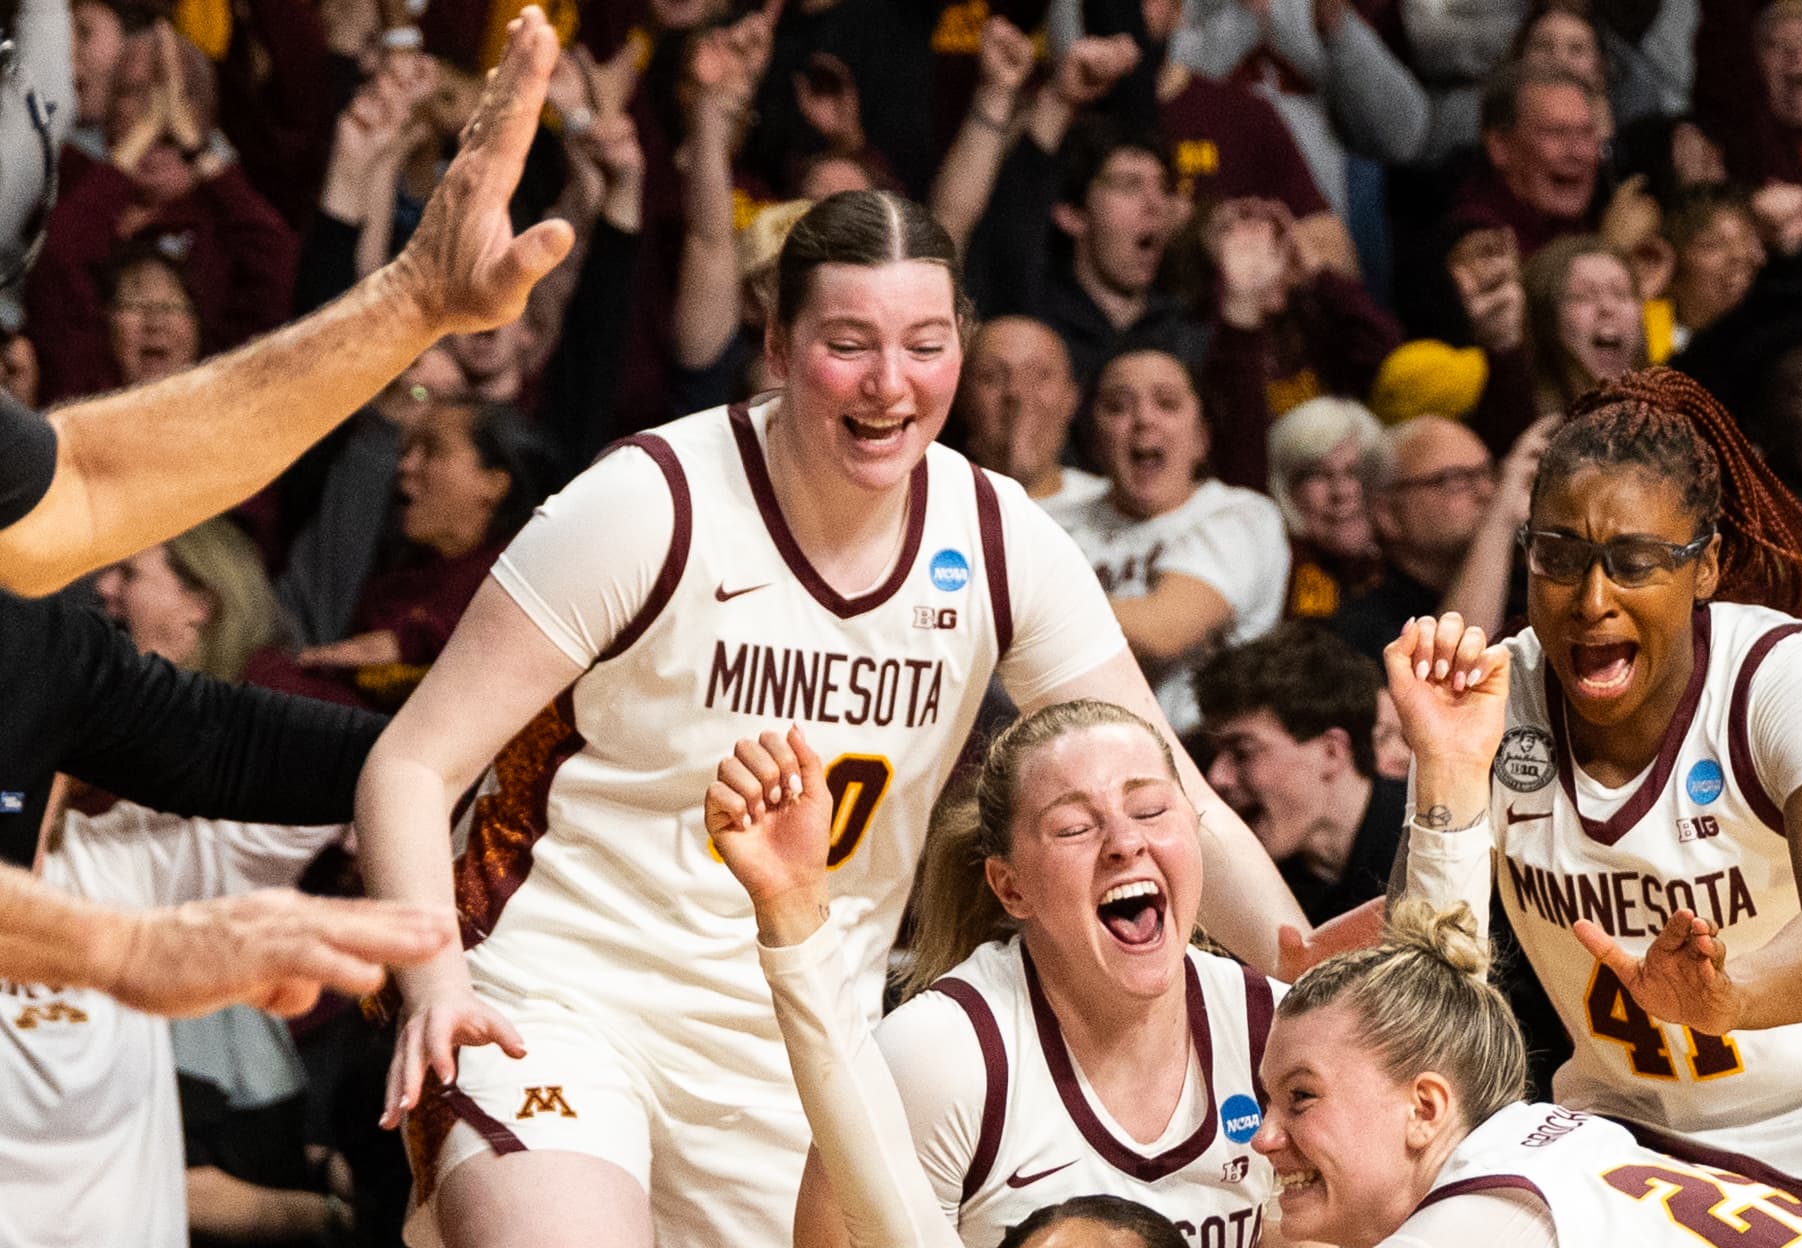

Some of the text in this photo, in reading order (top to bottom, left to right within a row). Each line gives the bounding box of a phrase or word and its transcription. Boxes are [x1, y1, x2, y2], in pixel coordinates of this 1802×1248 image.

[912, 606, 957, 630] BG
[704, 639, 944, 729] MINNESOTA
[1506, 855, 1758, 938] MINNESOTA
[516, 1086, 578, 1120] M
[1227, 1114, 1260, 1133] NCAA
